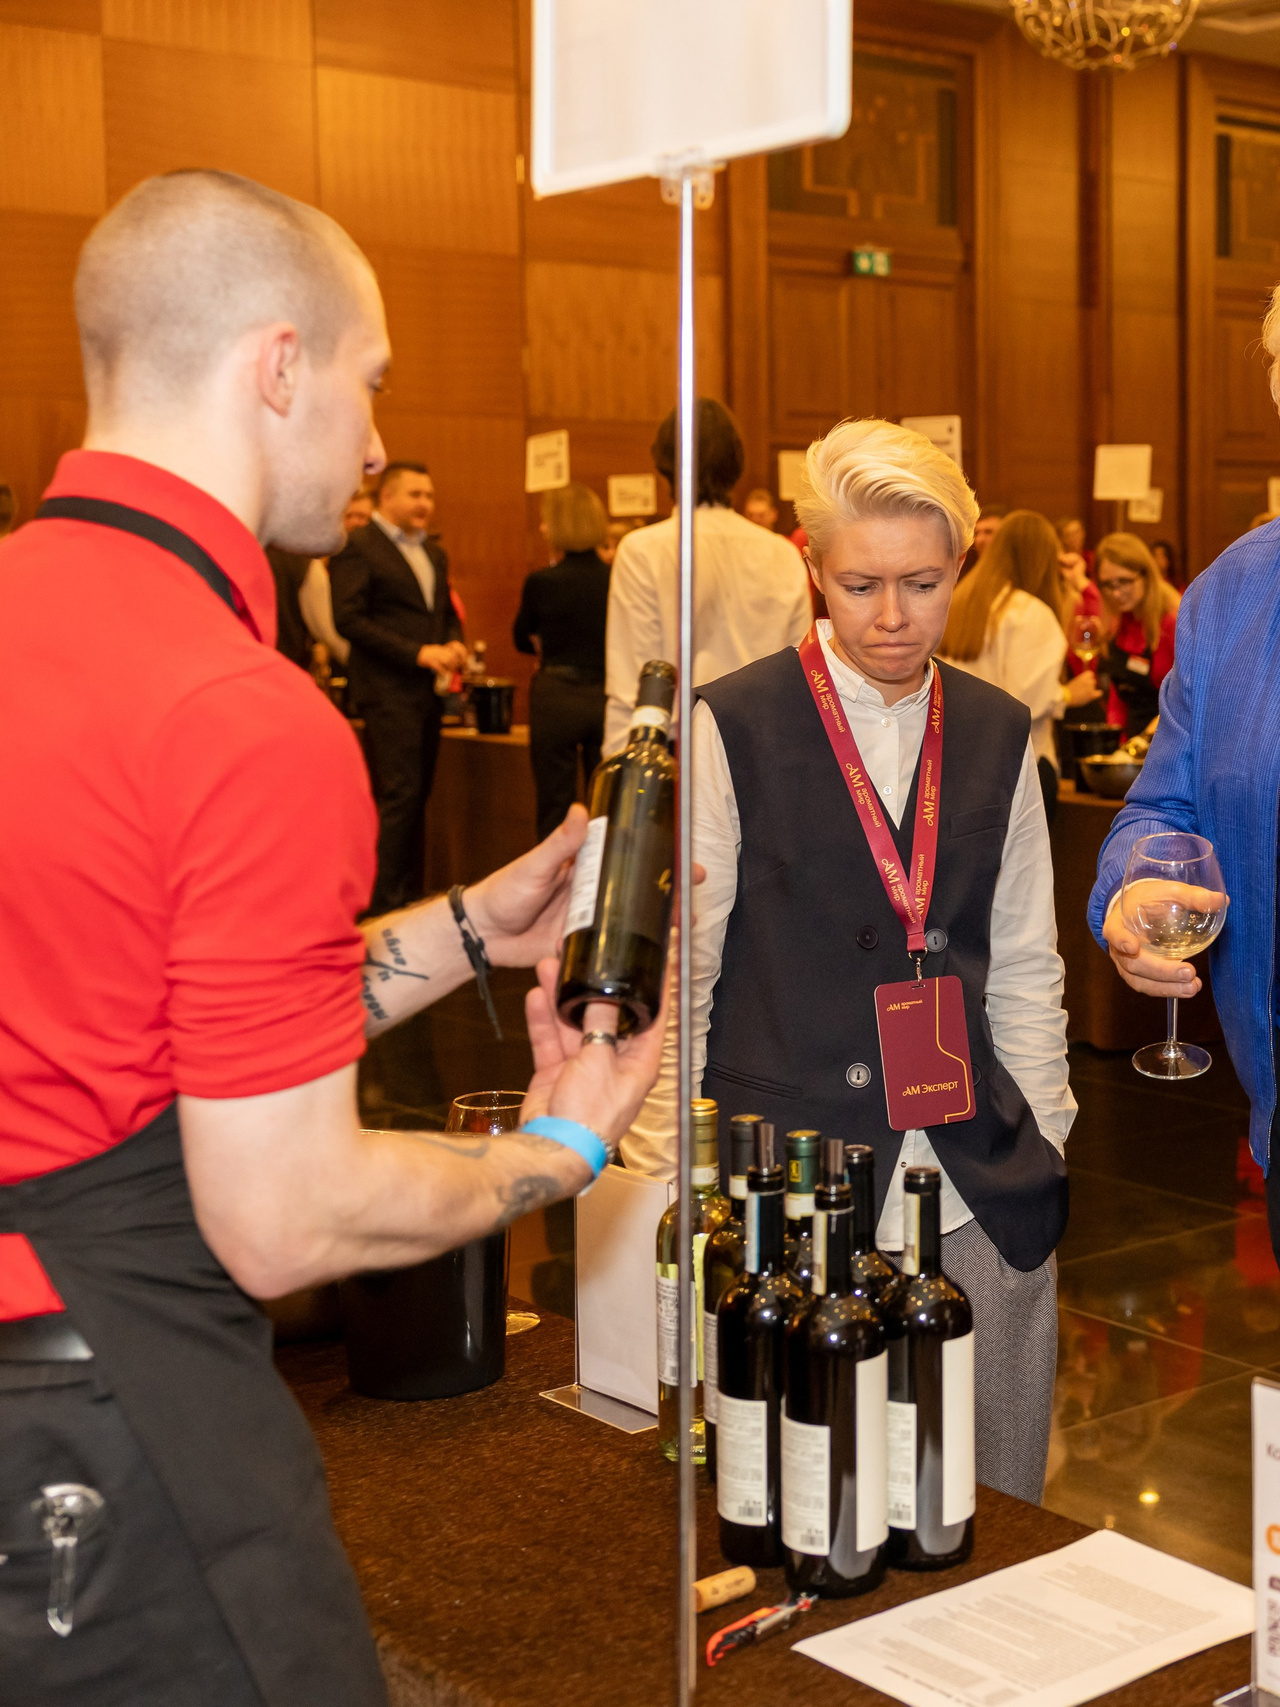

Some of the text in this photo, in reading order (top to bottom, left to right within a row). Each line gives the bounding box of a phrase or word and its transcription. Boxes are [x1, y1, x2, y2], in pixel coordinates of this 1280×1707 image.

[820, 695, 829, 710] мир
[826, 693, 845, 733] ароматный
[856, 789, 865, 805] мир
[924, 759, 932, 799] ароматный
[862, 788, 882, 828] ароматный
[891, 886, 900, 901] мир
[915, 854, 925, 895] ароматный
[897, 883, 916, 924] ароматный
[902, 1080, 958, 1097] АМ Эксперт
